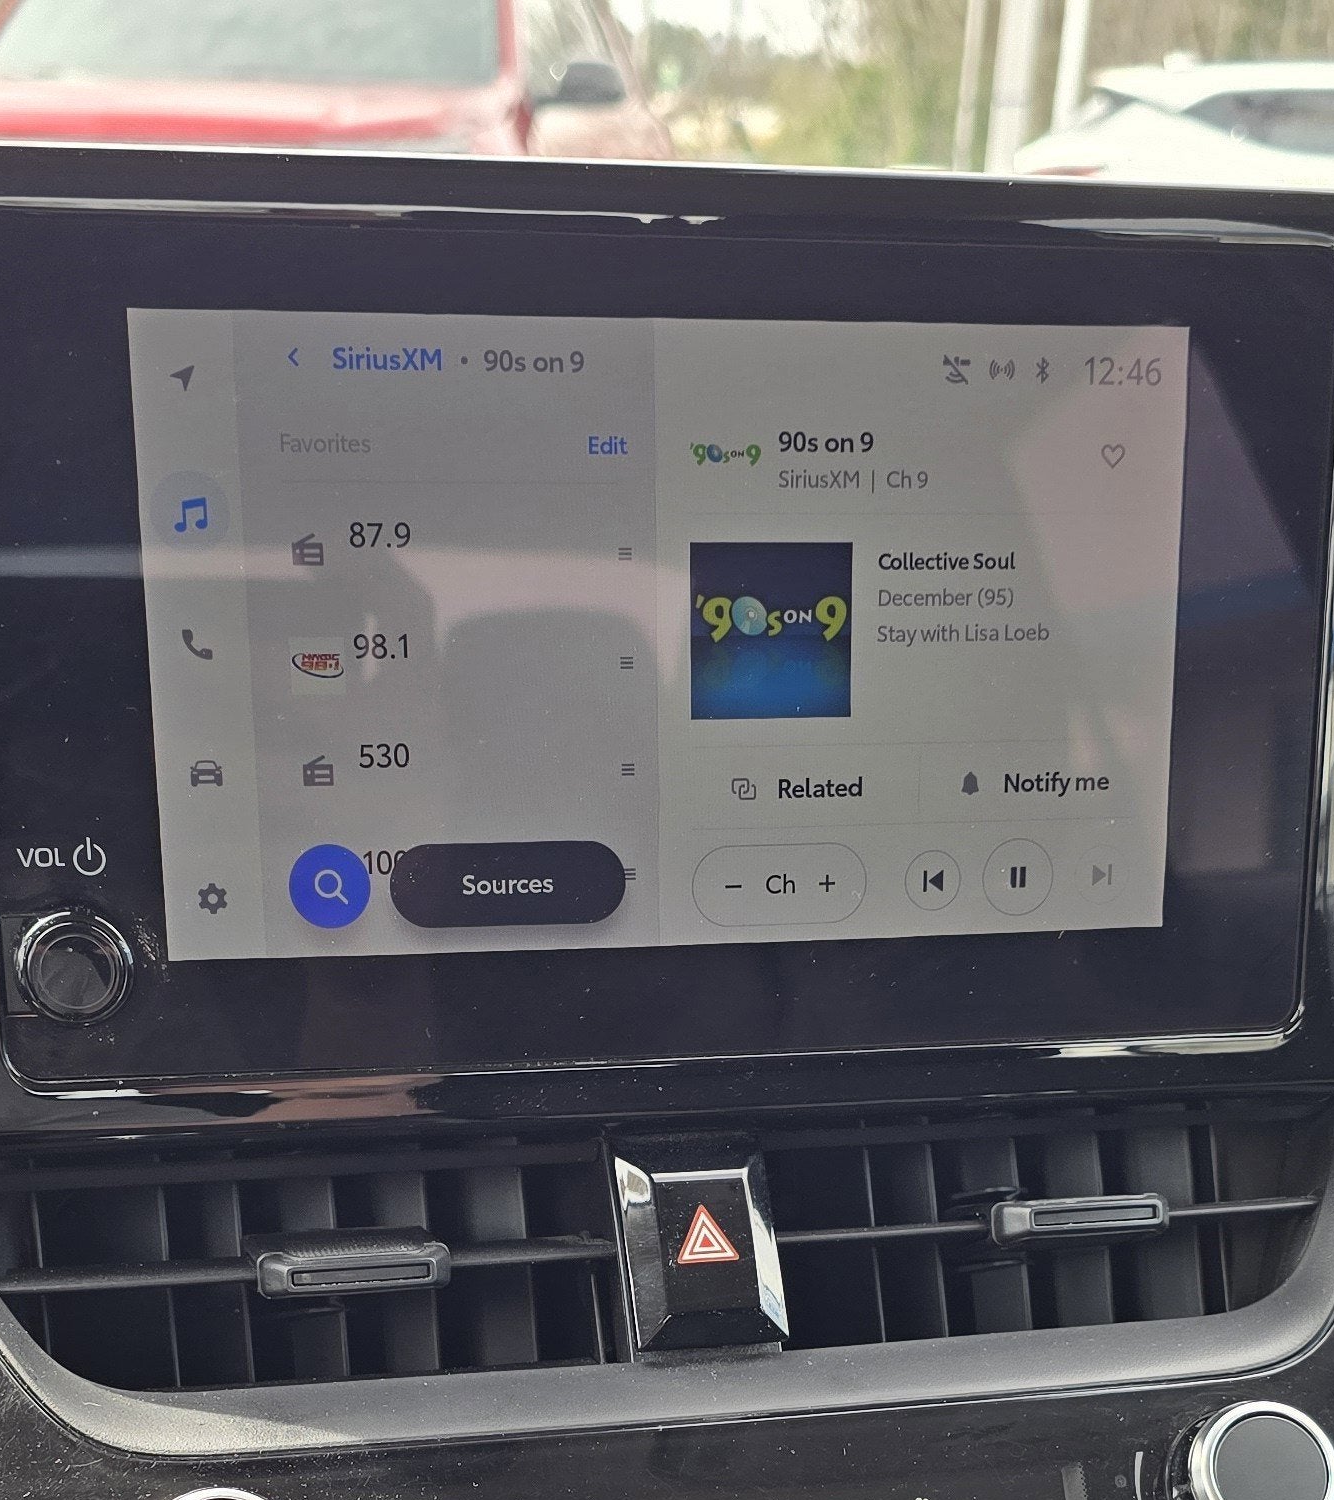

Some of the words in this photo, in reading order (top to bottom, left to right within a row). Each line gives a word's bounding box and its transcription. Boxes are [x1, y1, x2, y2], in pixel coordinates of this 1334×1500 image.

[331, 346, 444, 373] SiriusXM
[482, 348, 528, 374] 90s
[532, 354, 564, 374] on
[569, 351, 585, 374] 9
[1083, 355, 1163, 387] 12:46
[279, 432, 372, 455] Favorites
[587, 435, 629, 457] Edit
[778, 431, 819, 454] 90s
[823, 436, 853, 453] on
[859, 432, 874, 454] 9
[777, 468, 861, 490] SiriusXM
[885, 470, 912, 490] Ch
[916, 471, 929, 490] 9
[347, 521, 412, 549] 87.9
[878, 551, 969, 572] Collective
[972, 551, 1016, 572] Soul
[878, 587, 973, 608] December
[977, 587, 1015, 609] (95)
[782, 607, 813, 626] ON
[814, 594, 848, 641] 9
[876, 624, 917, 647] Stay
[920, 623, 960, 644] with
[964, 623, 1000, 643] Lisa
[1004, 623, 1050, 643] Loeb
[352, 633, 411, 661] 98.1
[358, 742, 410, 769] 530
[777, 776, 863, 799] Related
[1003, 772, 1071, 798] Notify
[1075, 775, 1110, 792] me
[16, 846, 66, 869] VOL
[461, 873, 554, 897] Sources
[765, 873, 797, 895] Ch
